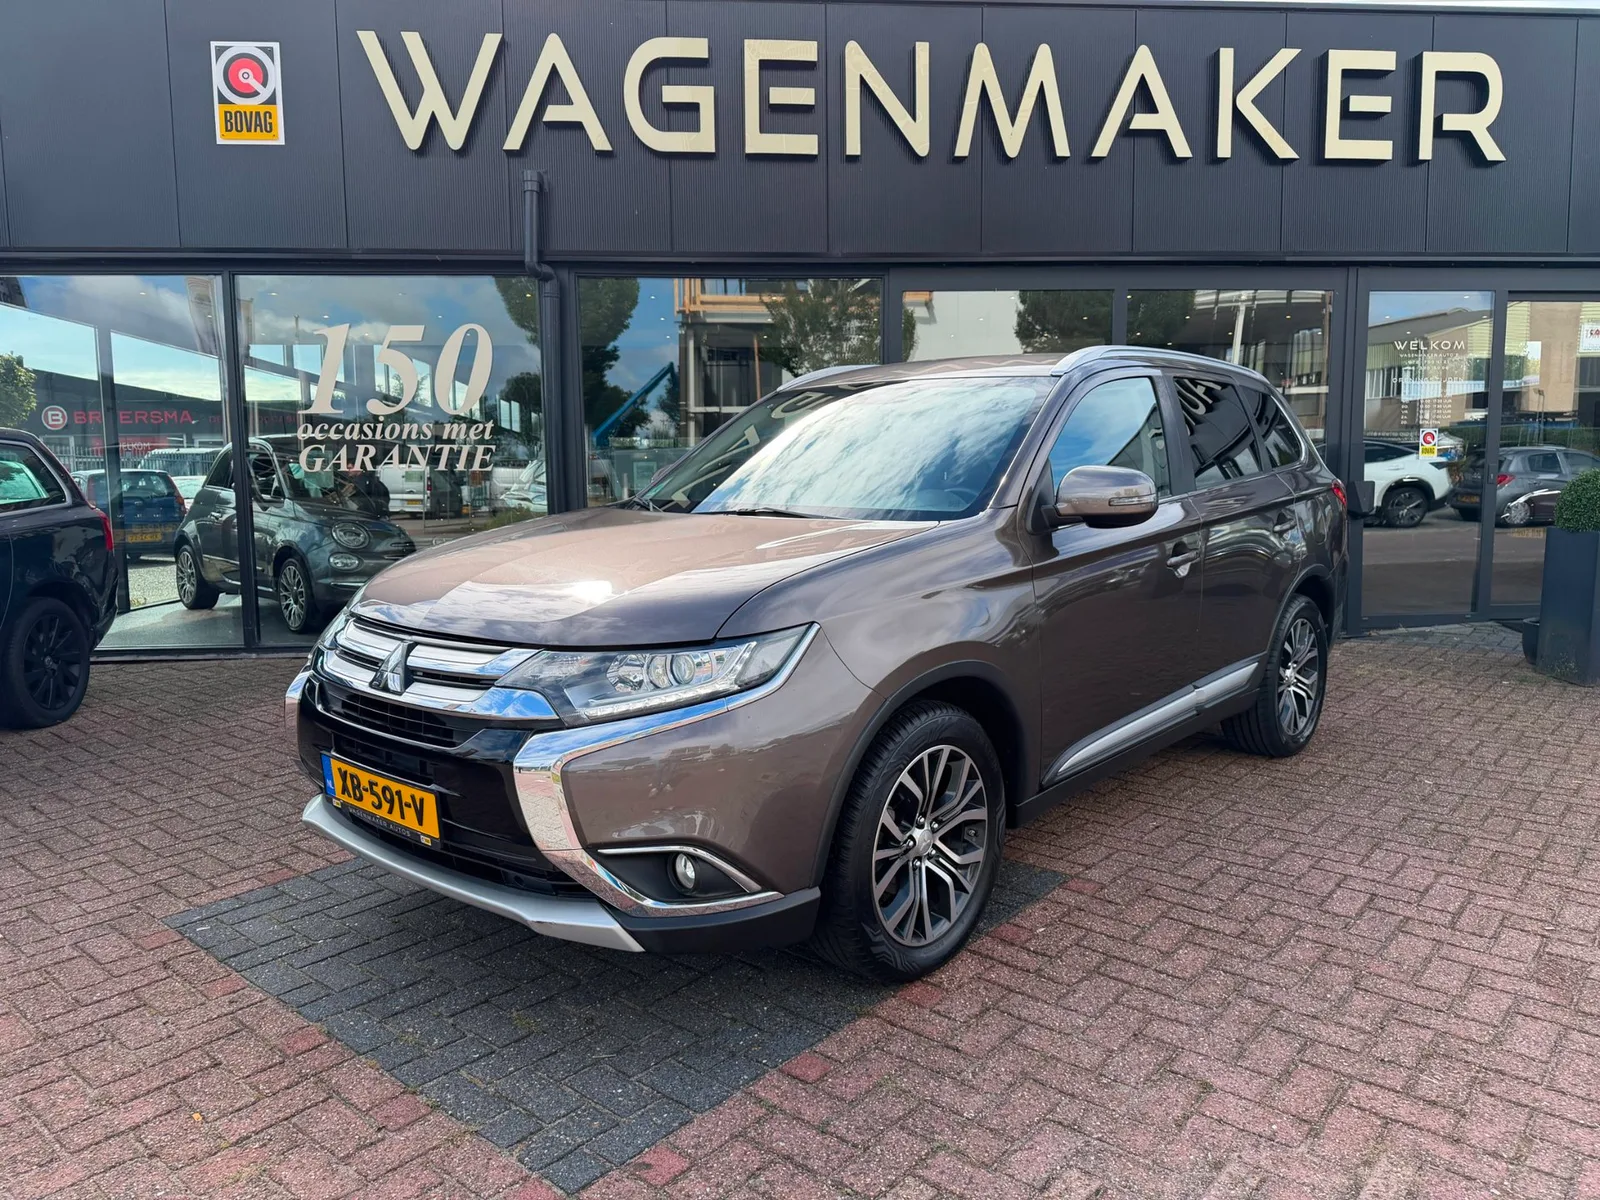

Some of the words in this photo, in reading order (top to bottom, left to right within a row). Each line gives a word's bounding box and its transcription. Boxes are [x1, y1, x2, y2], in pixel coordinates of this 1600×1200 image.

[356, 30, 1507, 161] WAGENMAKER
[223, 110, 274, 134] BOVAG
[1394, 341, 1465, 350] WELKOM
[298, 323, 493, 415] 150
[74, 410, 194, 424] BRERSMA
[297, 415, 433, 440] occasions
[442, 419, 495, 440] met
[119, 441, 151, 451] ELKOM
[299, 444, 497, 472] GARANTIE
[338, 767, 425, 827] XB-591-V
